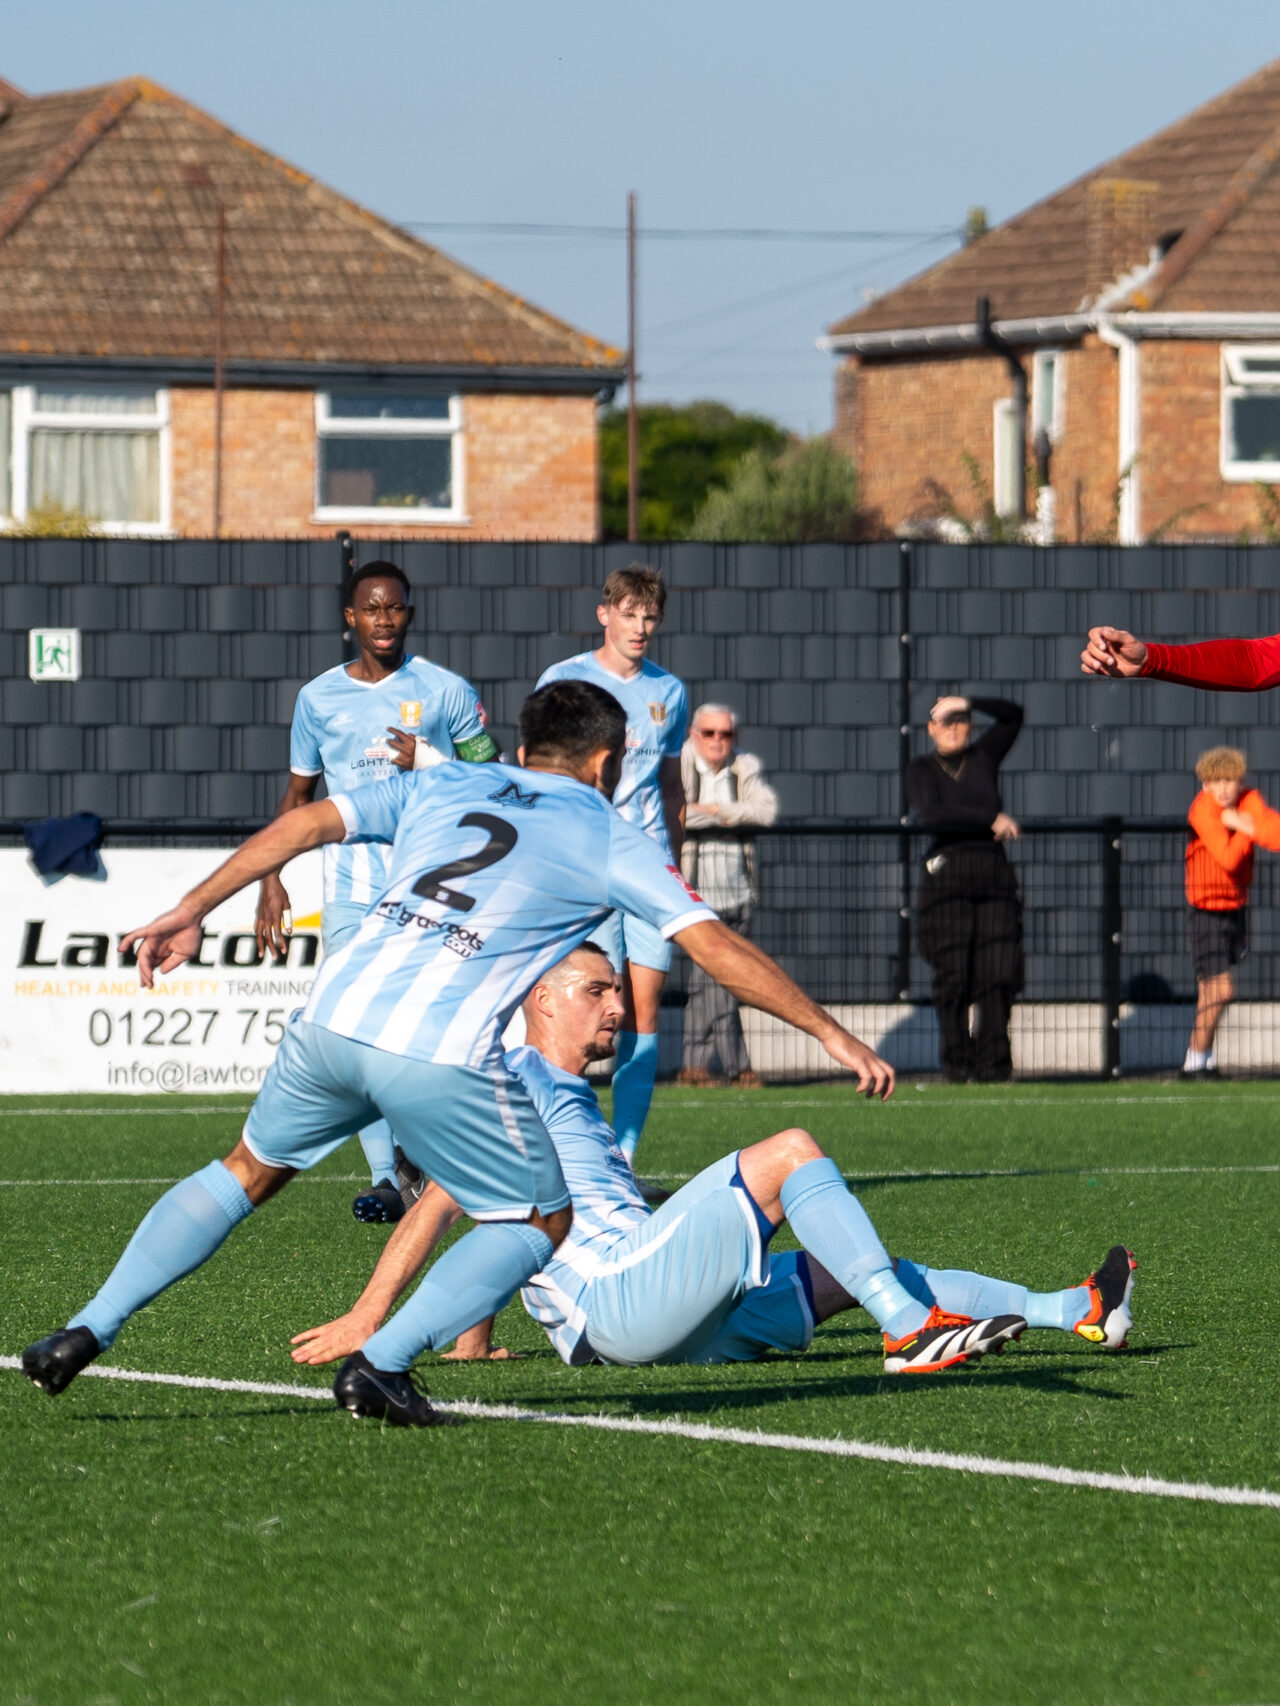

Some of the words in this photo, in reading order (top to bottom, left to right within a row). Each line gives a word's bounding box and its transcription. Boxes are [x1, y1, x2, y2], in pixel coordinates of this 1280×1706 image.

[411, 811, 518, 913] 2
[16, 919, 319, 969] Laton
[14, 980, 91, 996] HEALTH
[97, 980, 138, 996] AND
[145, 980, 220, 997] SAFETY
[88, 1007, 220, 1047] 01227
